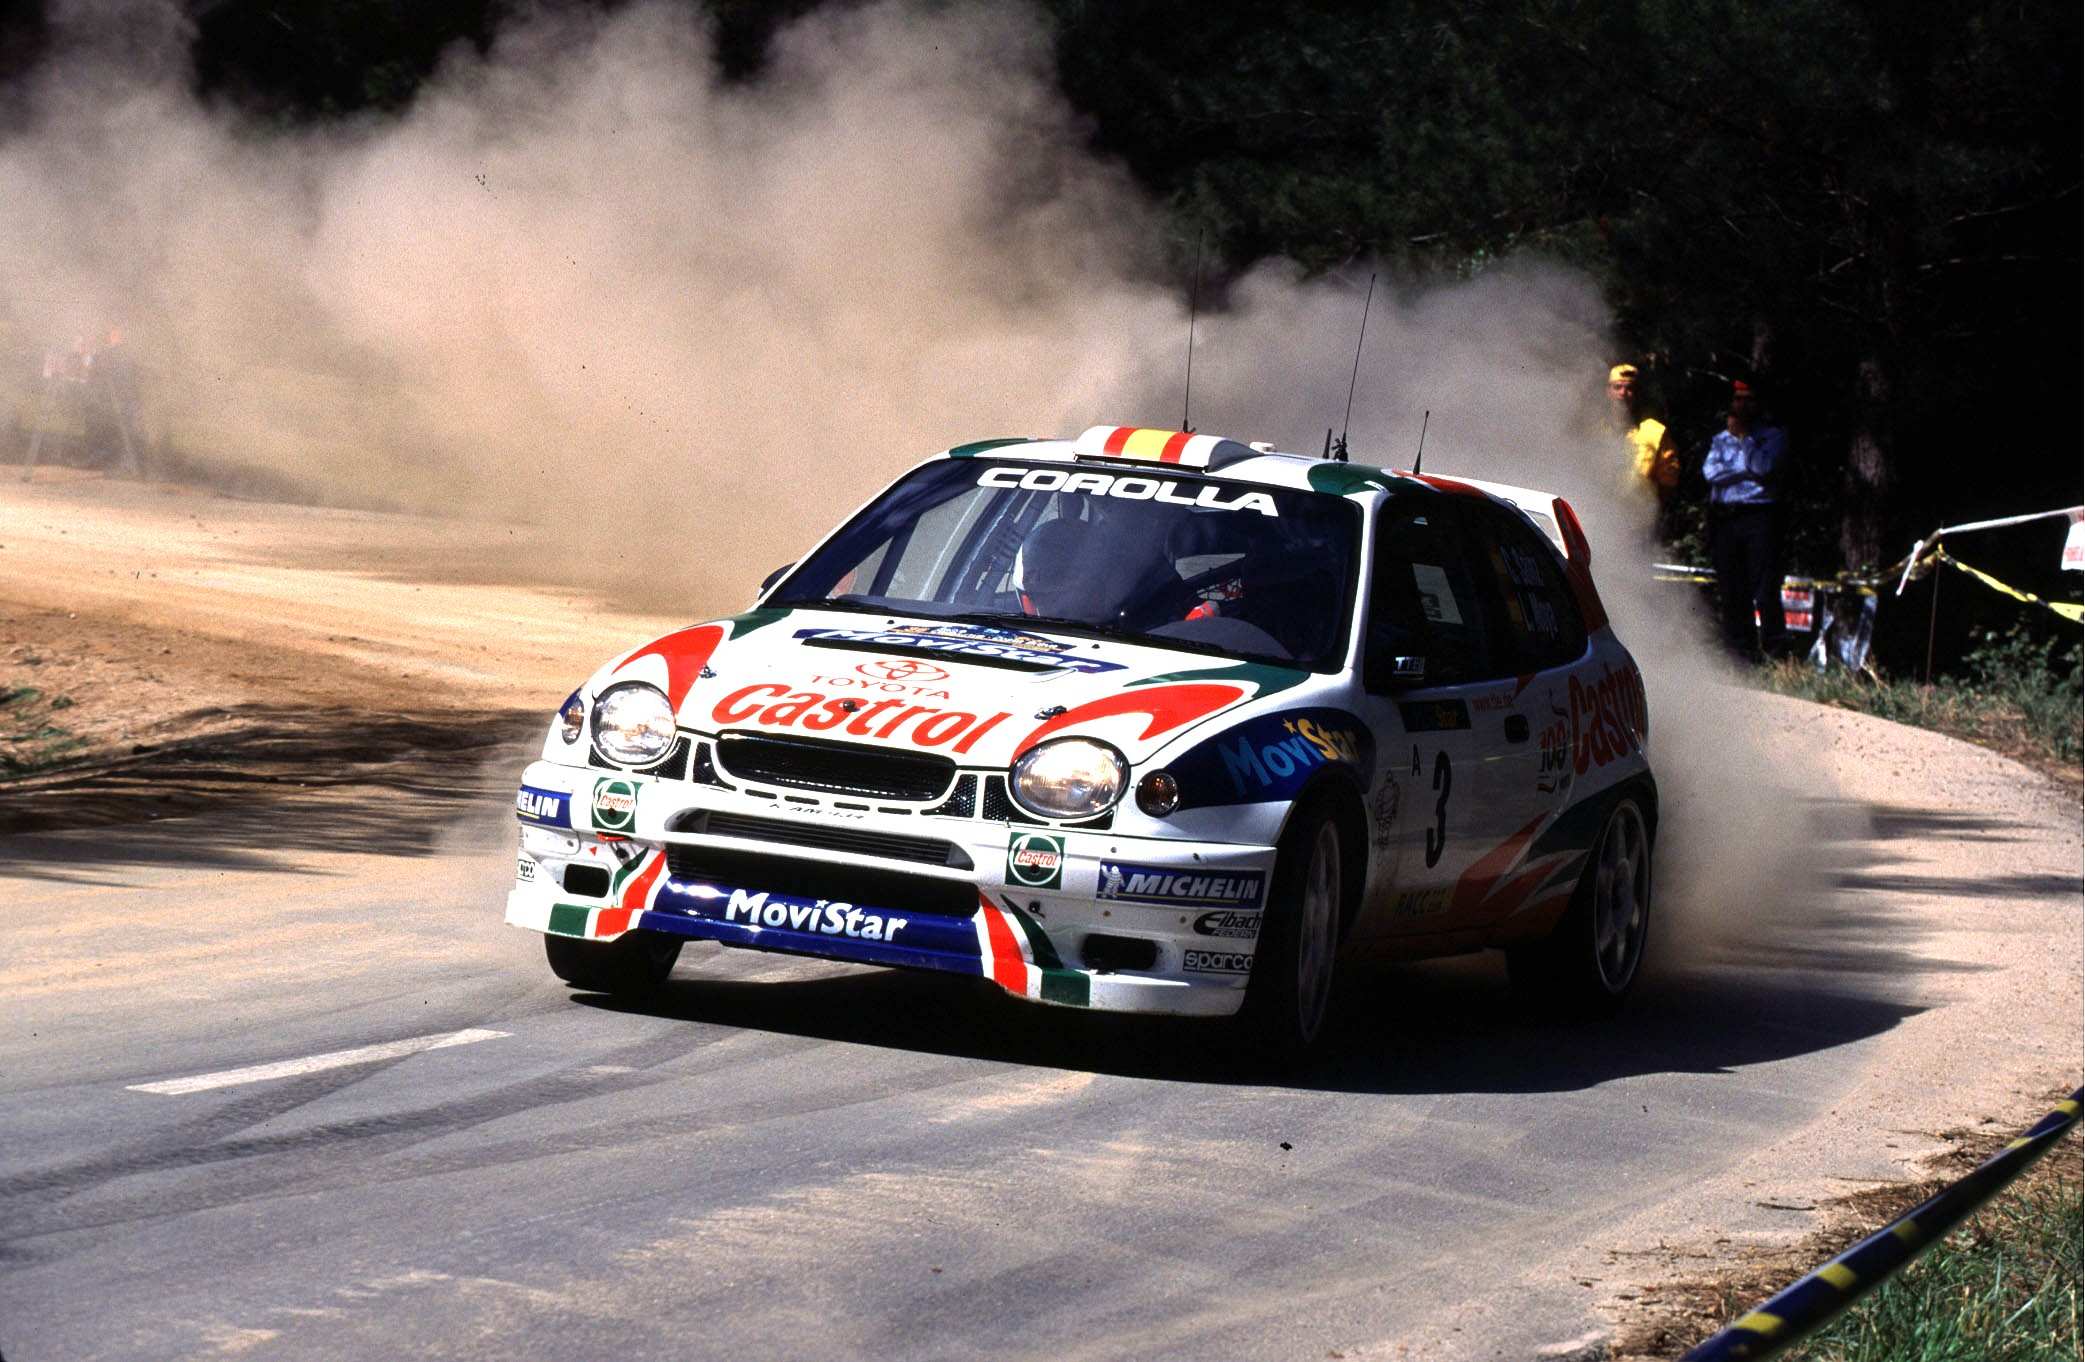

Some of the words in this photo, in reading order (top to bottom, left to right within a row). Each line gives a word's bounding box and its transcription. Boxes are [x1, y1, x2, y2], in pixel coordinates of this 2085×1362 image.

[976, 467, 1280, 517] COROLLA
[811, 673, 950, 700] TOYOTA
[711, 682, 1014, 755] Castrol
[1411, 744, 1422, 777] A
[600, 793, 635, 810] Castrol
[1425, 750, 1452, 869] 3
[1017, 850, 1059, 867] Castrol
[1125, 873, 1260, 900] MICHELIN
[725, 889, 908, 943] MoviStar
[1185, 951, 1254, 971] sparco
